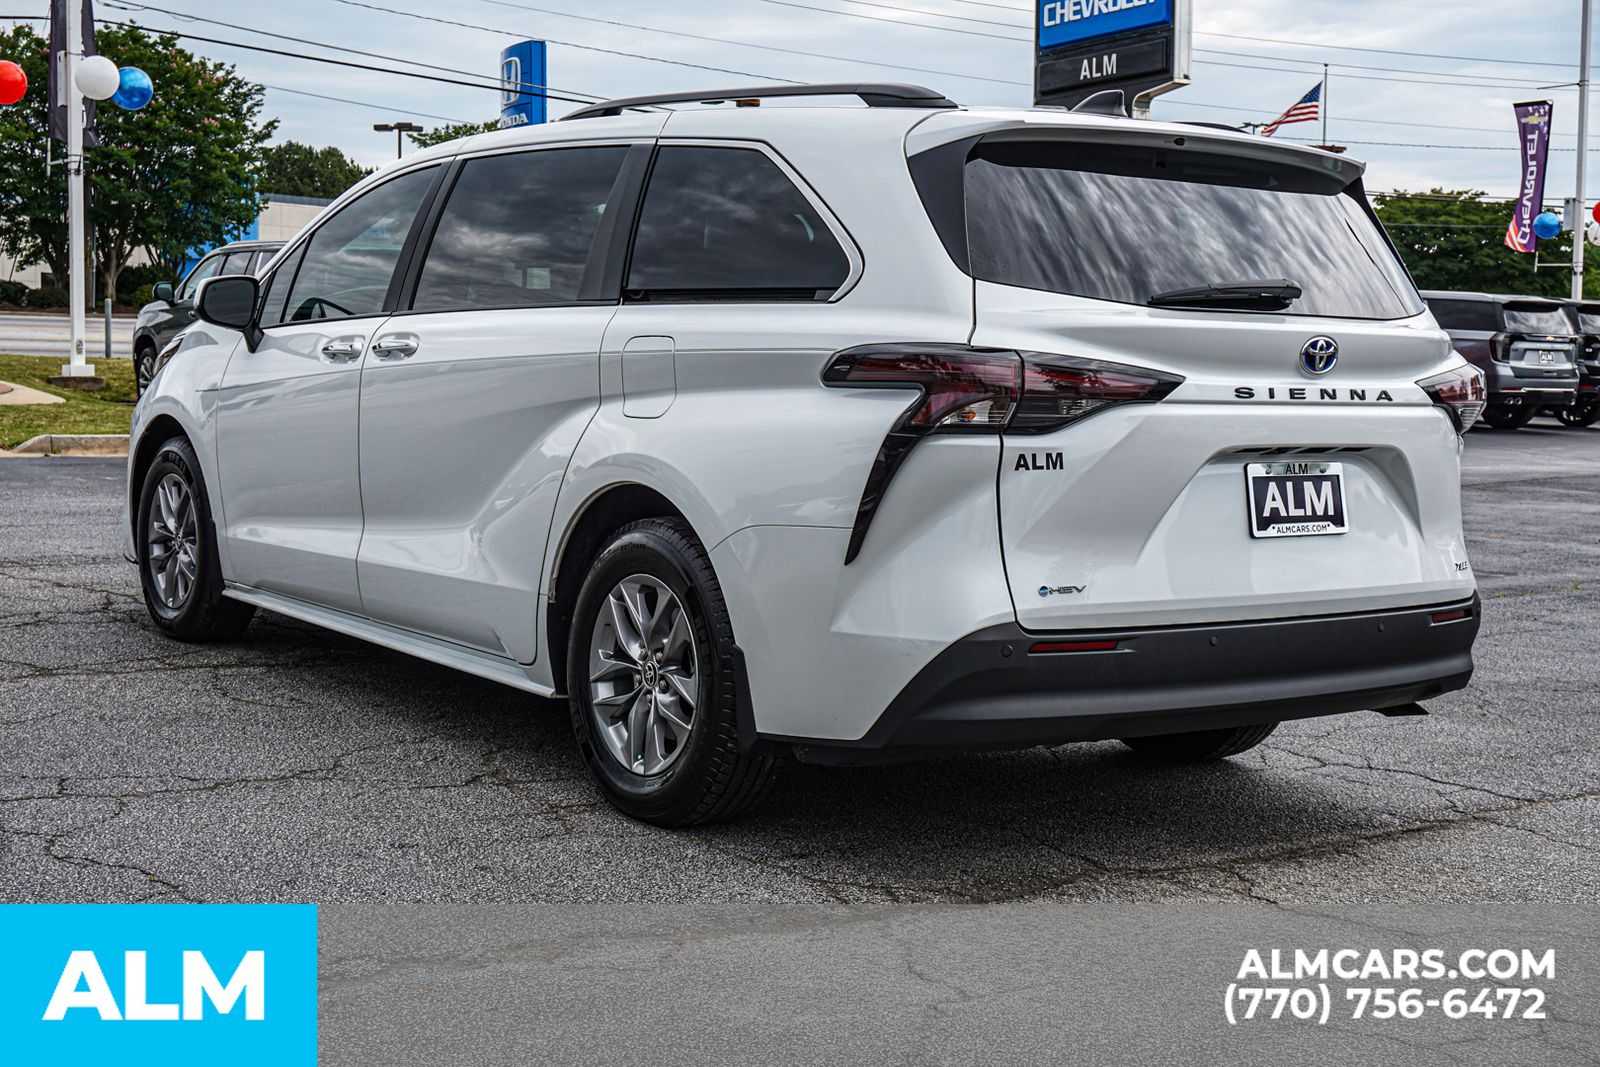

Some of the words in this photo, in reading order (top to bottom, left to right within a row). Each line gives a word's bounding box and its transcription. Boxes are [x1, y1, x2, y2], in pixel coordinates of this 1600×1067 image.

[1043, 0, 1155, 27] CHEVRO
[1080, 53, 1117, 80] ALM
[1234, 386, 1394, 402] SIENNA
[1014, 452, 1064, 471] ALM
[1285, 463, 1309, 475] ALM
[1262, 481, 1335, 517] ALM
[1276, 525, 1328, 534] ALMCARS.COM
